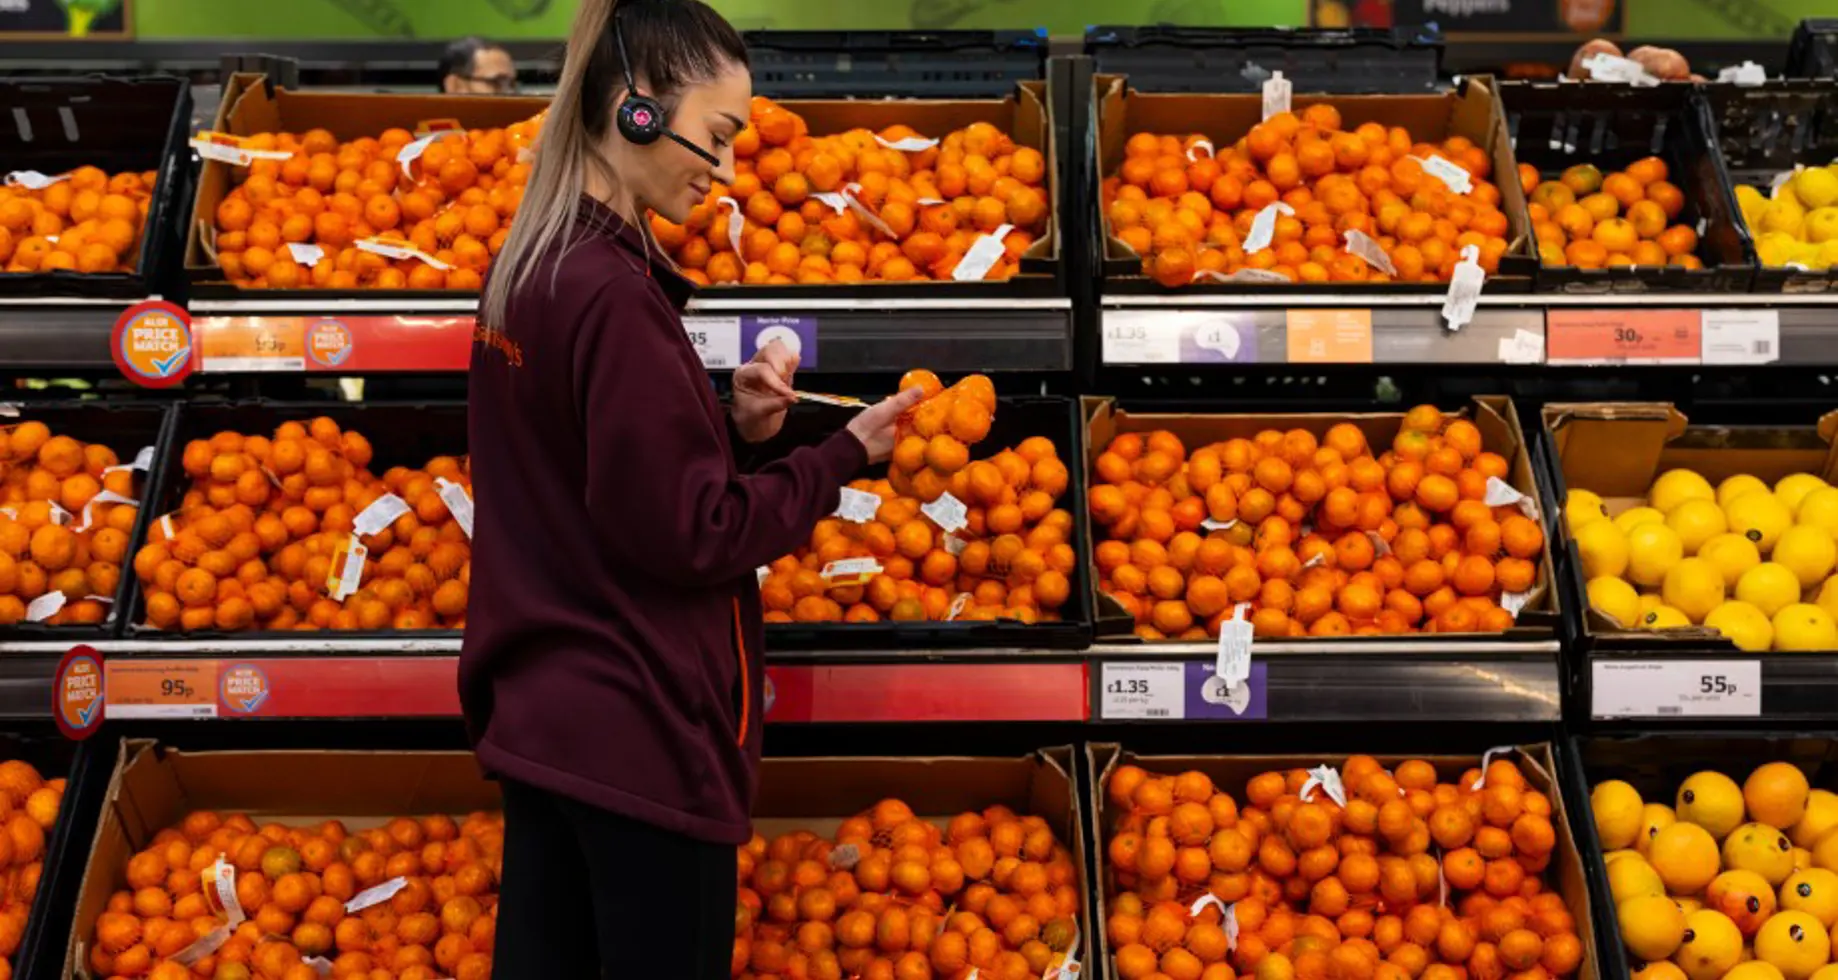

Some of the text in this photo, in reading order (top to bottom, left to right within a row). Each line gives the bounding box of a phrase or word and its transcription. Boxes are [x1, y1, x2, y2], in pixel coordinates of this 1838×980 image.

[132, 327, 178, 340] PRICE
[1614, 327, 1643, 344] 30p
[132, 339, 178, 352] MATCH
[66, 674, 96, 689] PRICE
[161, 678, 195, 699] 95p
[227, 677, 260, 686] PRICE
[1107, 679, 1149, 694] £1.35
[1700, 675, 1737, 696] 55p
[67, 687, 96, 702] MATCH
[227, 685, 260, 694] MATCH
